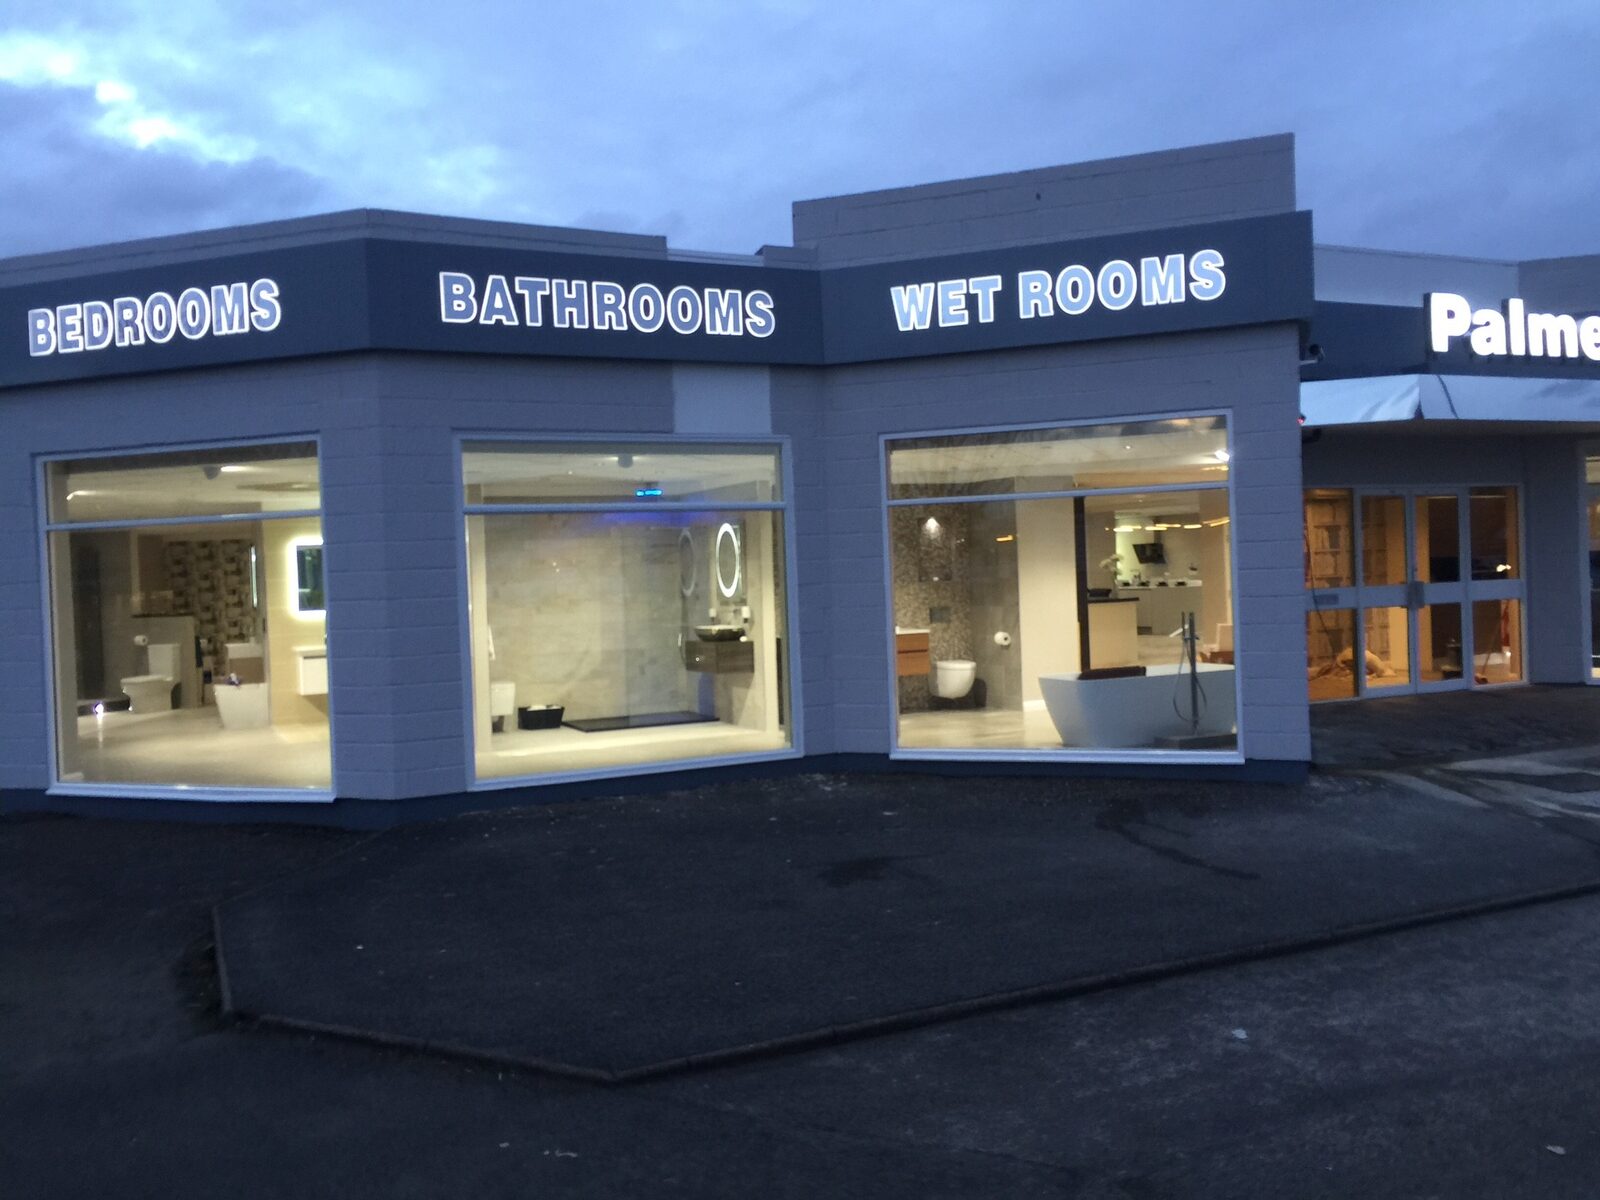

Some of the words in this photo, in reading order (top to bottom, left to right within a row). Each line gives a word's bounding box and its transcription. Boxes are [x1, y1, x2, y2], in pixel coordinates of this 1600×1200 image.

[27, 277, 282, 357] BEDROOMS
[437, 270, 777, 339] BATHROOMS
[889, 273, 1003, 332] WET
[1017, 248, 1226, 320] ROOMS
